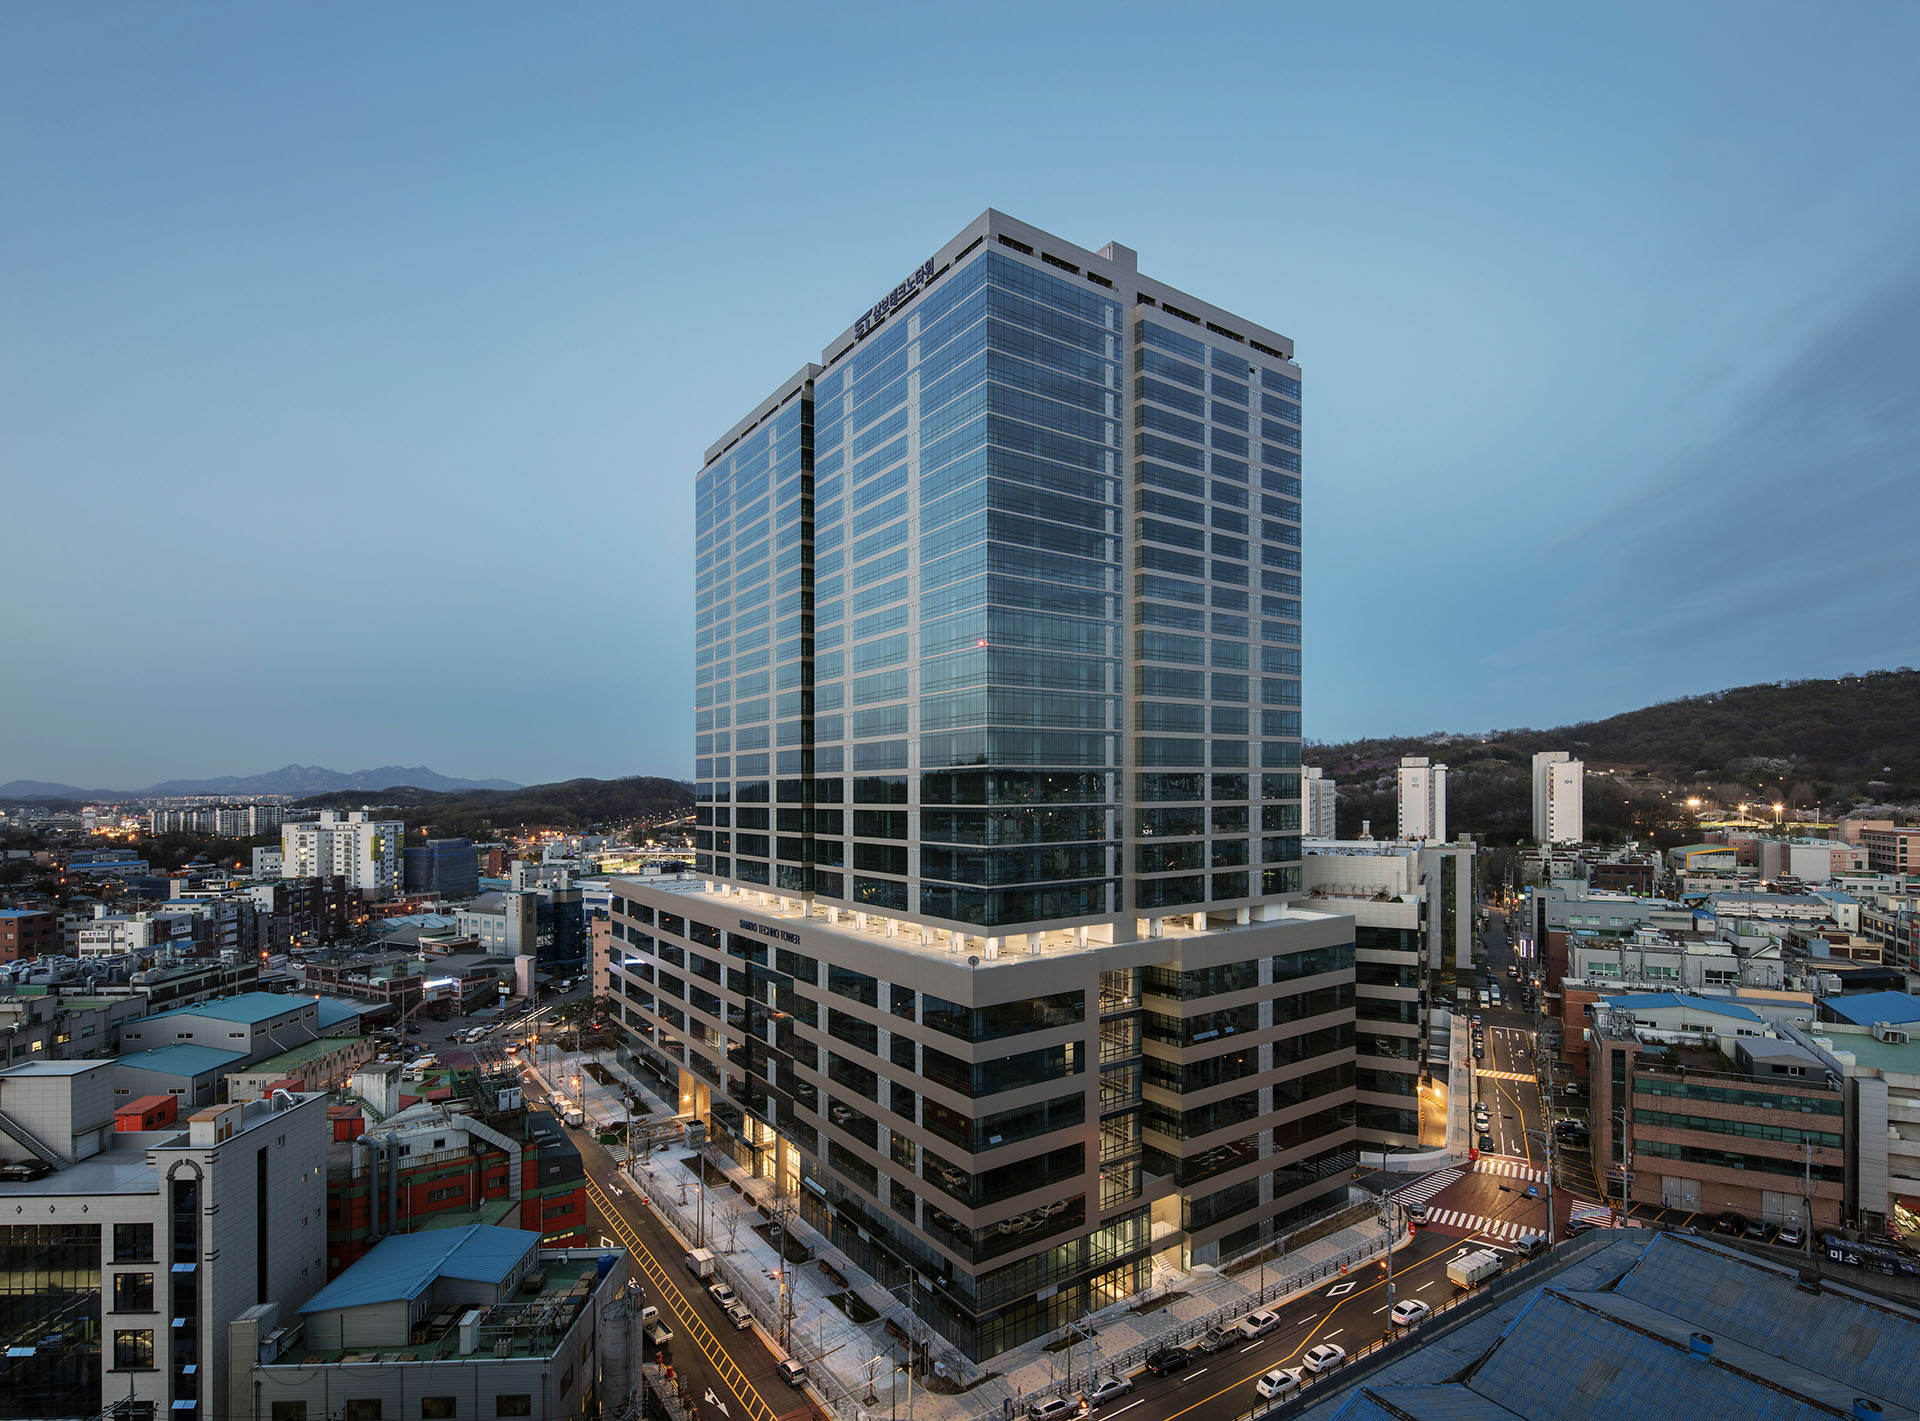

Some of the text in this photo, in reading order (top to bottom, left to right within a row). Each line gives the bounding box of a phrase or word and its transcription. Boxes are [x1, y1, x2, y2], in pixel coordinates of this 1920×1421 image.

[873, 256, 935, 322] 삼보테크노타워
[758, 924, 780, 939] TECHNO
[780, 929, 801, 945] TOWER
